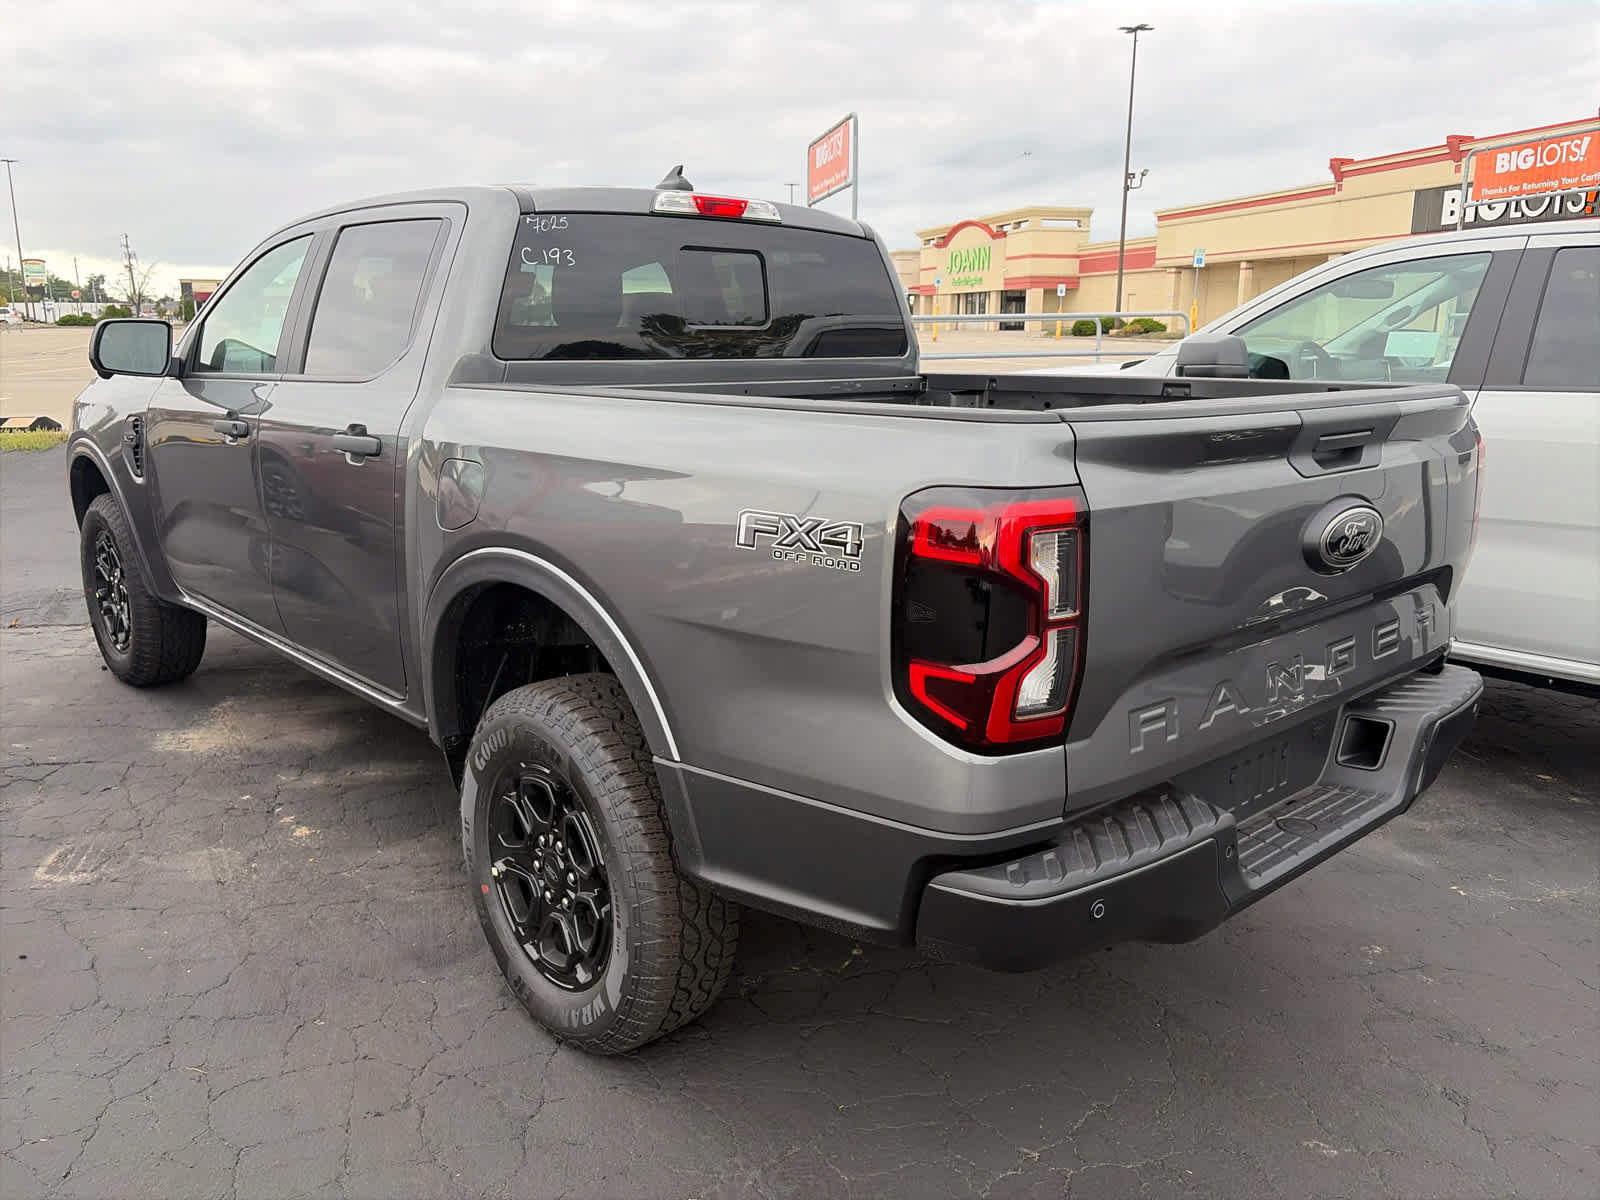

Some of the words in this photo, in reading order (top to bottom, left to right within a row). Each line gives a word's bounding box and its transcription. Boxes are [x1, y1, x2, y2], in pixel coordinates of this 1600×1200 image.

[1481, 186, 1507, 197] Thanks
[1508, 184, 1521, 193] For
[1522, 179, 1559, 191] Returning
[1561, 176, 1579, 185] Your
[946, 245, 992, 274] JOANN
[736, 508, 864, 560] FX4
[773, 549, 807, 563] OFF
[812, 554, 861, 572] ROAD
[1127, 602, 1437, 754] RANGER
